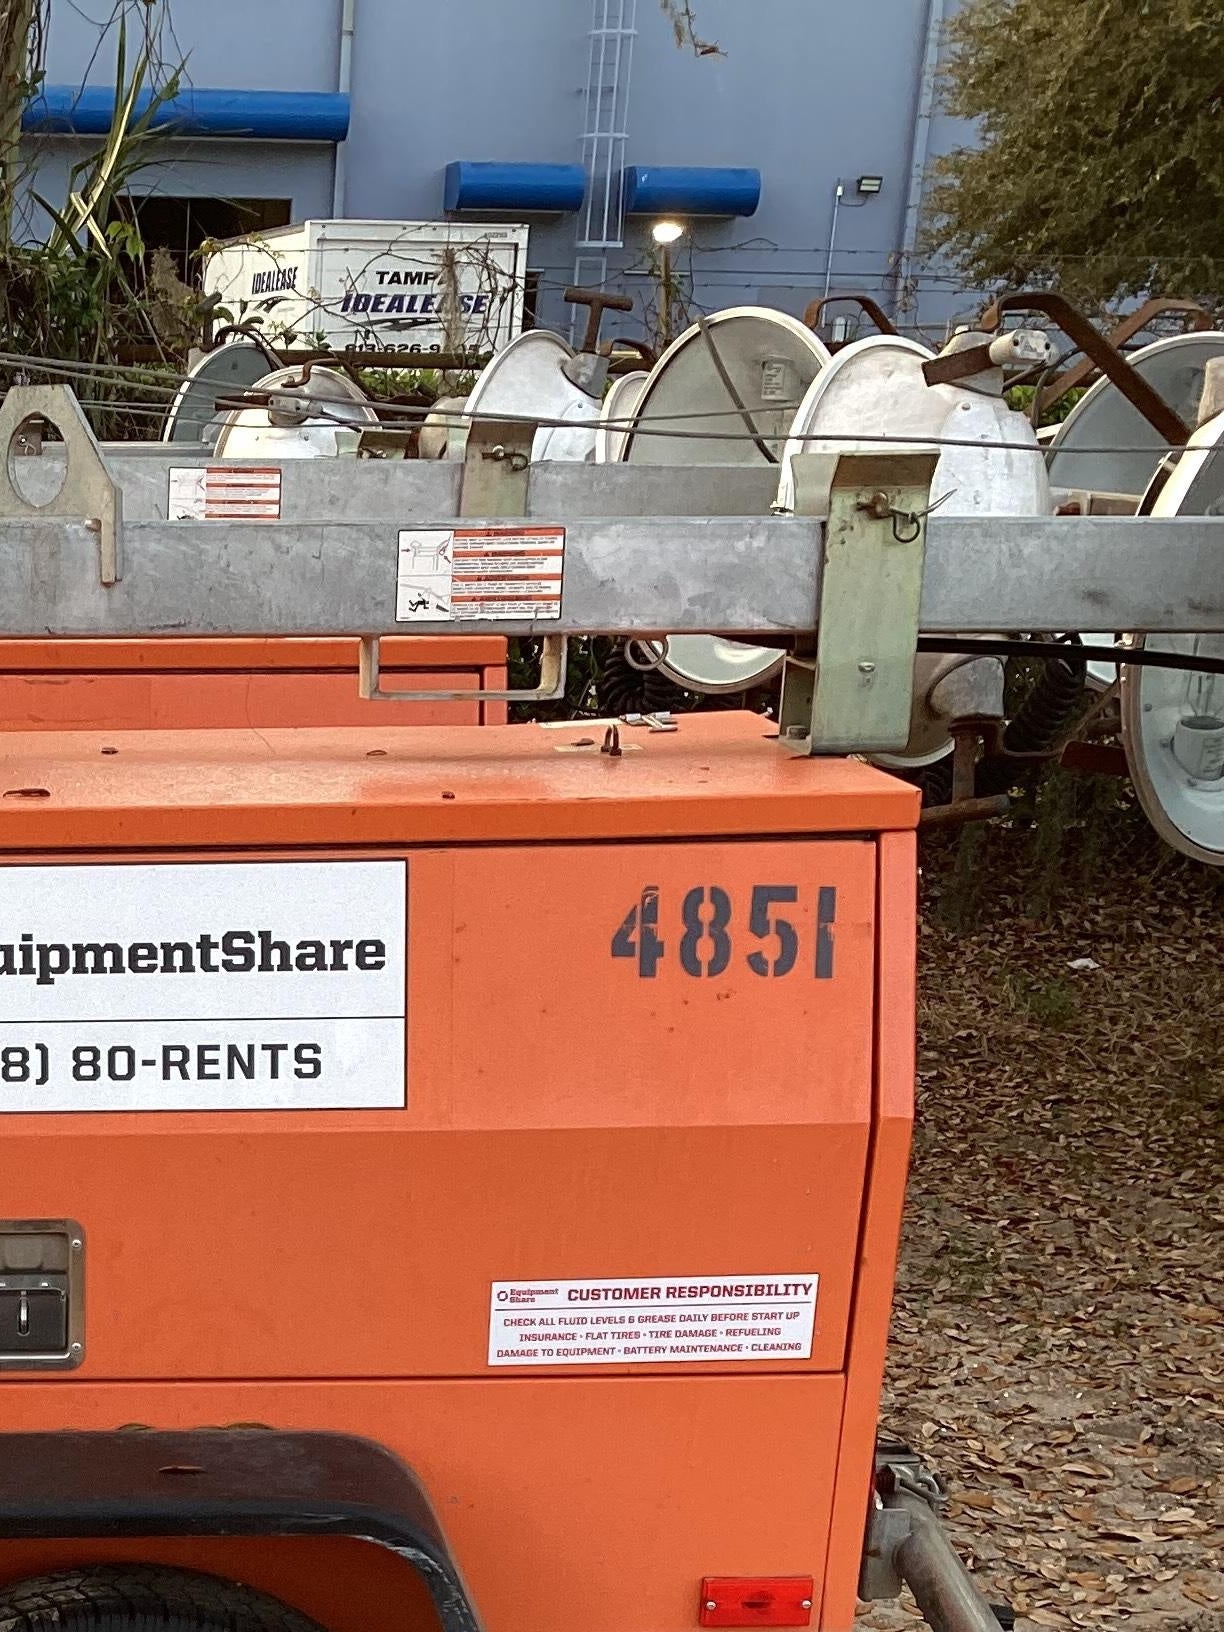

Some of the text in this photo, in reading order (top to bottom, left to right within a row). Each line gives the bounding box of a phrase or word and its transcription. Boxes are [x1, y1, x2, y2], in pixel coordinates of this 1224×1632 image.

[251, 266, 298, 295] IDEALEASE
[610, 884, 837, 979] 4851
[71, 1042, 323, 1082] 80-RENTS
[509, 1287, 559, 1297] Equipment
[567, 1283, 813, 1302] CUSTOMER RESPONSIBILITY
[503, 1318, 537, 1327] CHECK
[538, 1317, 556, 1326] ALL
[558, 1316, 588, 1326] FLUID
[590, 1315, 626, 1325] LEVELS
[637, 1314, 677, 1324] GREASE
[679, 1313, 709, 1323] DAILY
[710, 1312, 750, 1322] BEFORE
[751, 1311, 784, 1321] START
[785, 1311, 800, 1320] UP
[519, 1327, 781, 1342] INSURANCE FLAT TIRES TIRE DAMAGE REFUELING
[496, 1342, 802, 1358] DAMAGE TO EQUIPMENT BATTERY MAINTENANCE CLEANING
